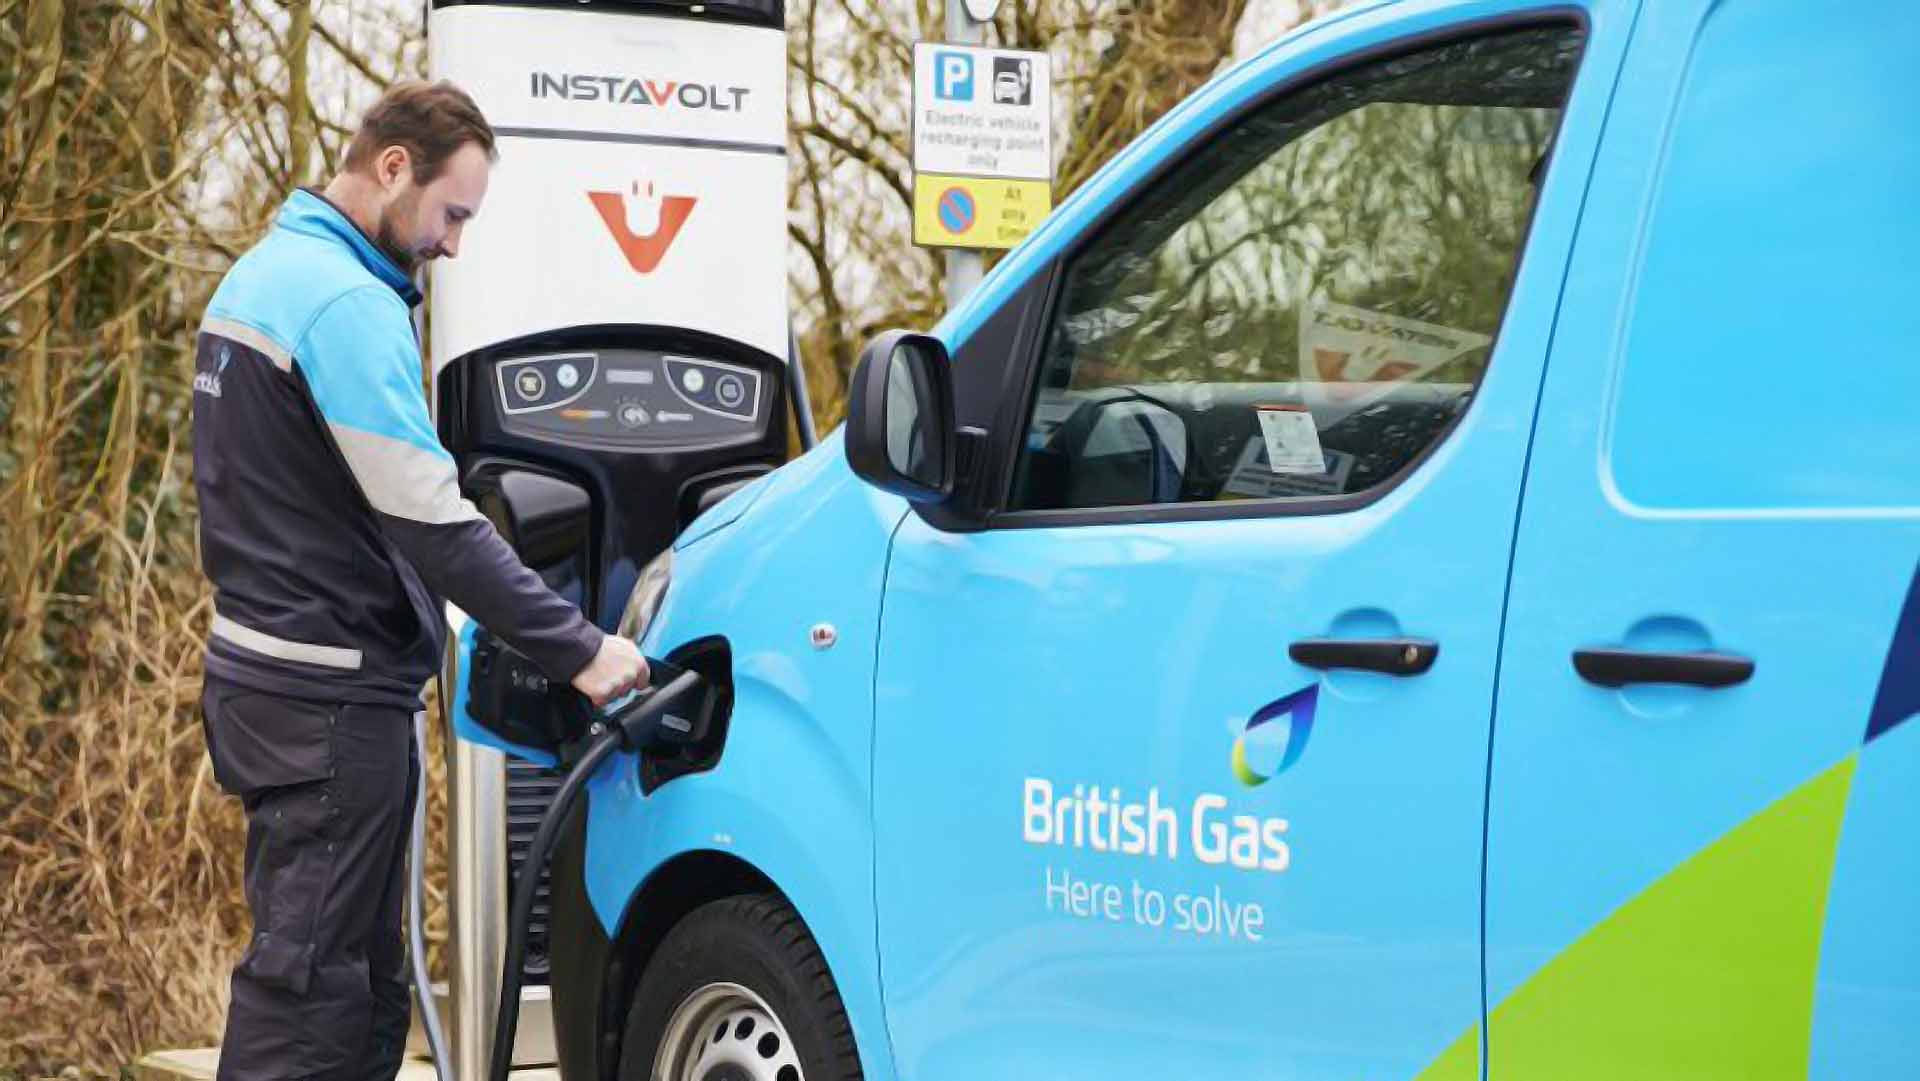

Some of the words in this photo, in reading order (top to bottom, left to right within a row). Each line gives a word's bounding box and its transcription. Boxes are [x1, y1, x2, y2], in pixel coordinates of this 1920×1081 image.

[530, 72, 750, 112] INSTAVOLT
[943, 56, 969, 97] P
[925, 110, 984, 127] Electric
[1023, 777, 1178, 860] British
[1191, 793, 1291, 872] Gas
[1045, 865, 1122, 921] Here
[1131, 879, 1166, 927] to
[1173, 884, 1265, 942] solve
